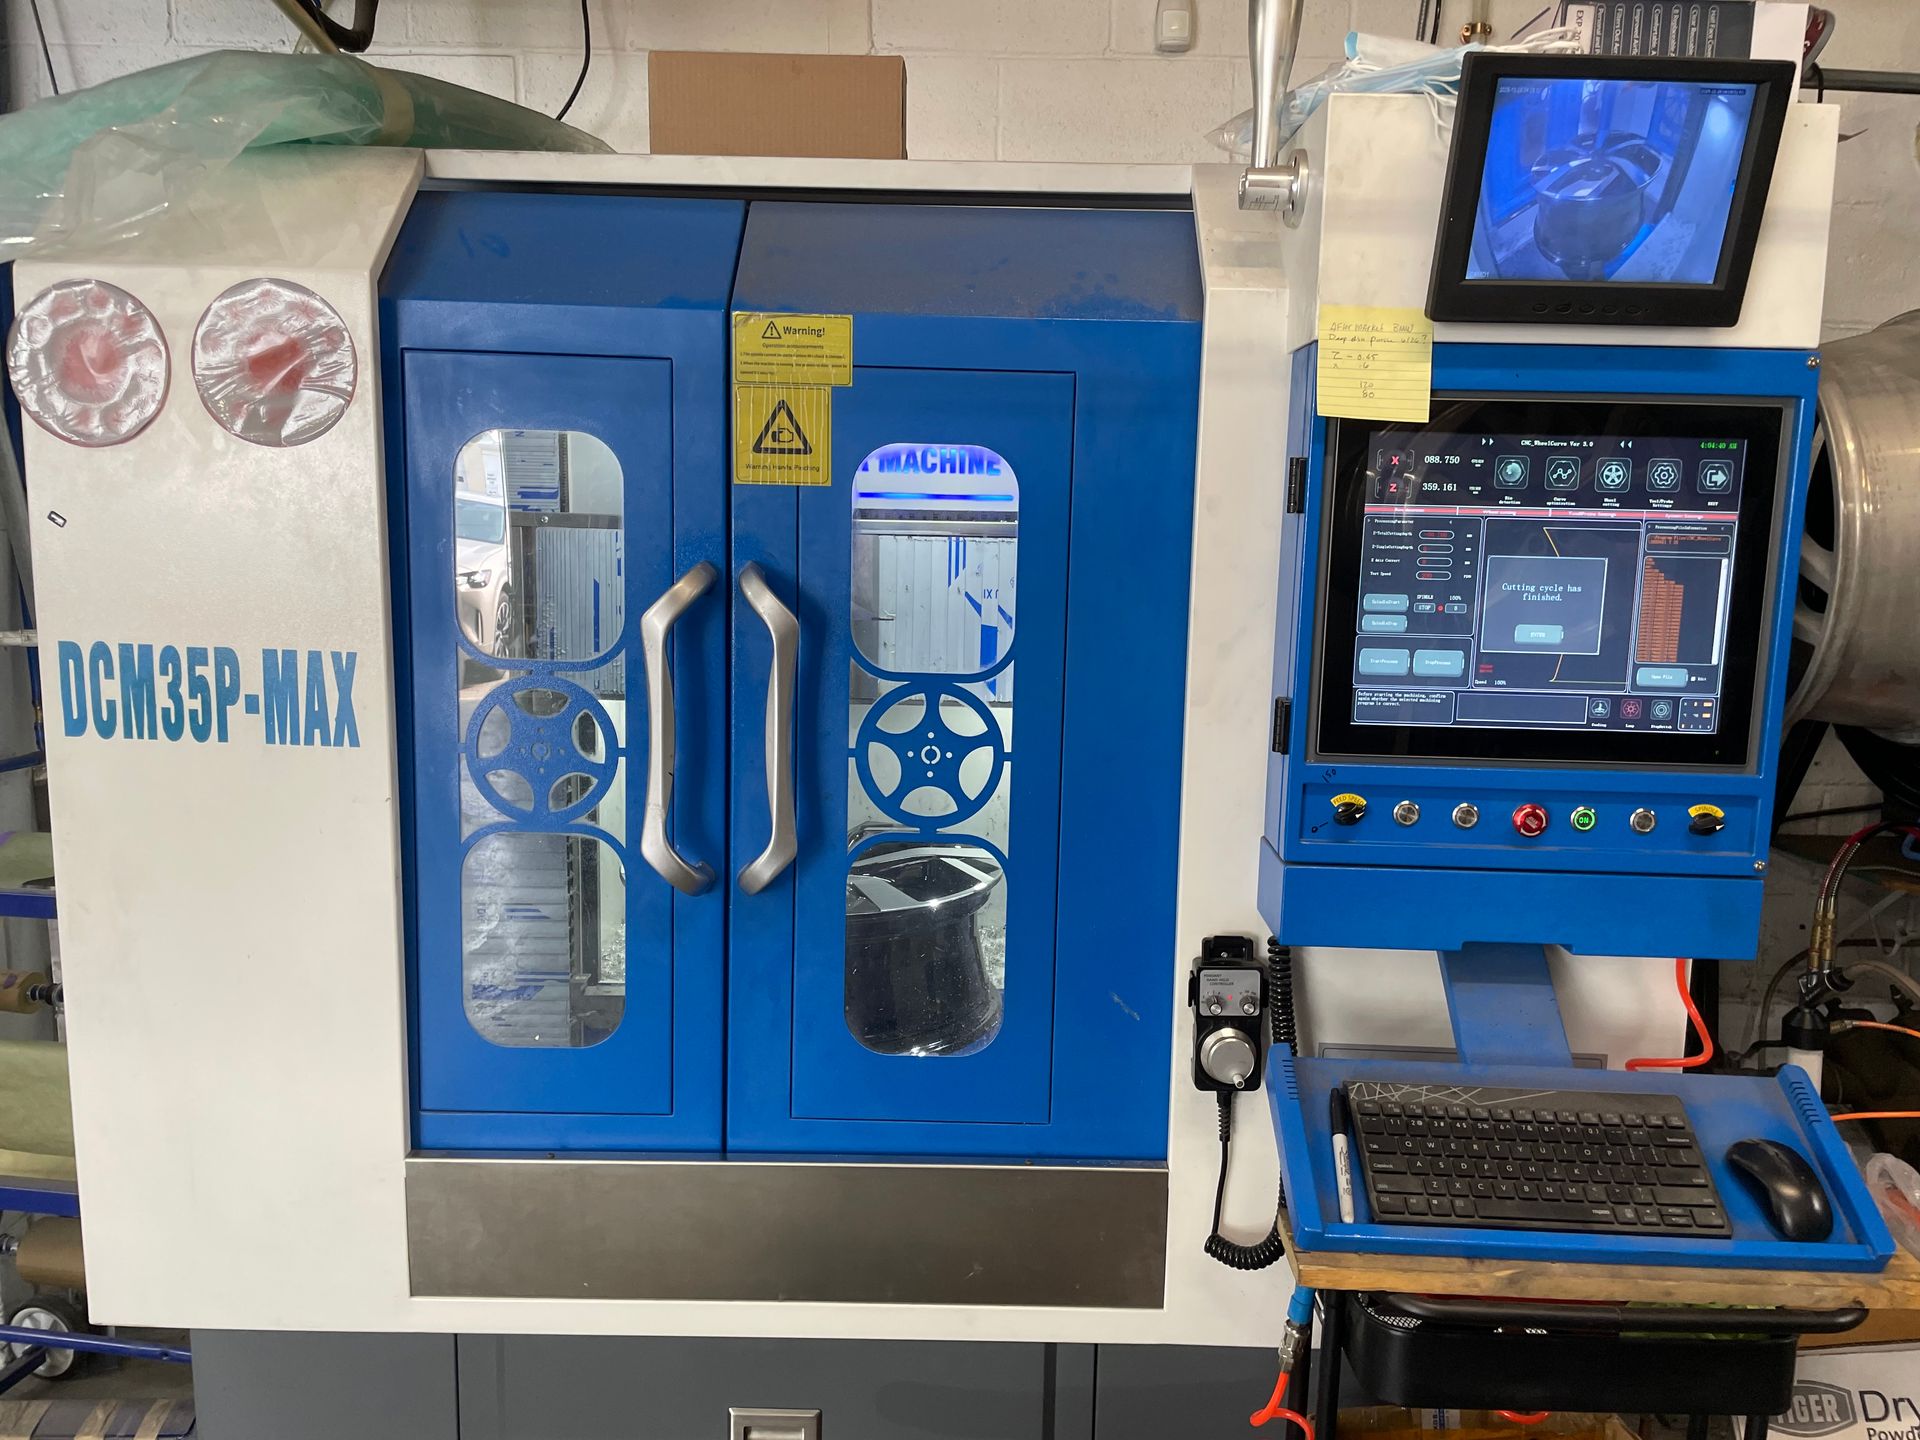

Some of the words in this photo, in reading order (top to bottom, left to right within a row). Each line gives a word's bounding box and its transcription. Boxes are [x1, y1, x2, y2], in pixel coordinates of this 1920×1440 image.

[783, 326, 825, 337] Warning!
[878, 447, 1002, 476] MACHINE
[1391, 456, 1399, 465] X
[1424, 456, 1460, 464] 088.750
[1389, 483, 1398, 492] Z
[1422, 483, 1457, 491] 359.161
[1502, 583, 1535, 592] Cutting
[1539, 584, 1563, 592] cycle
[1523, 593, 1563, 601] finished.
[57, 640, 360, 748] DCM35P-MAX
[1332, 796, 1347, 805] FEED
[1776, 1394, 1841, 1424] IGER
